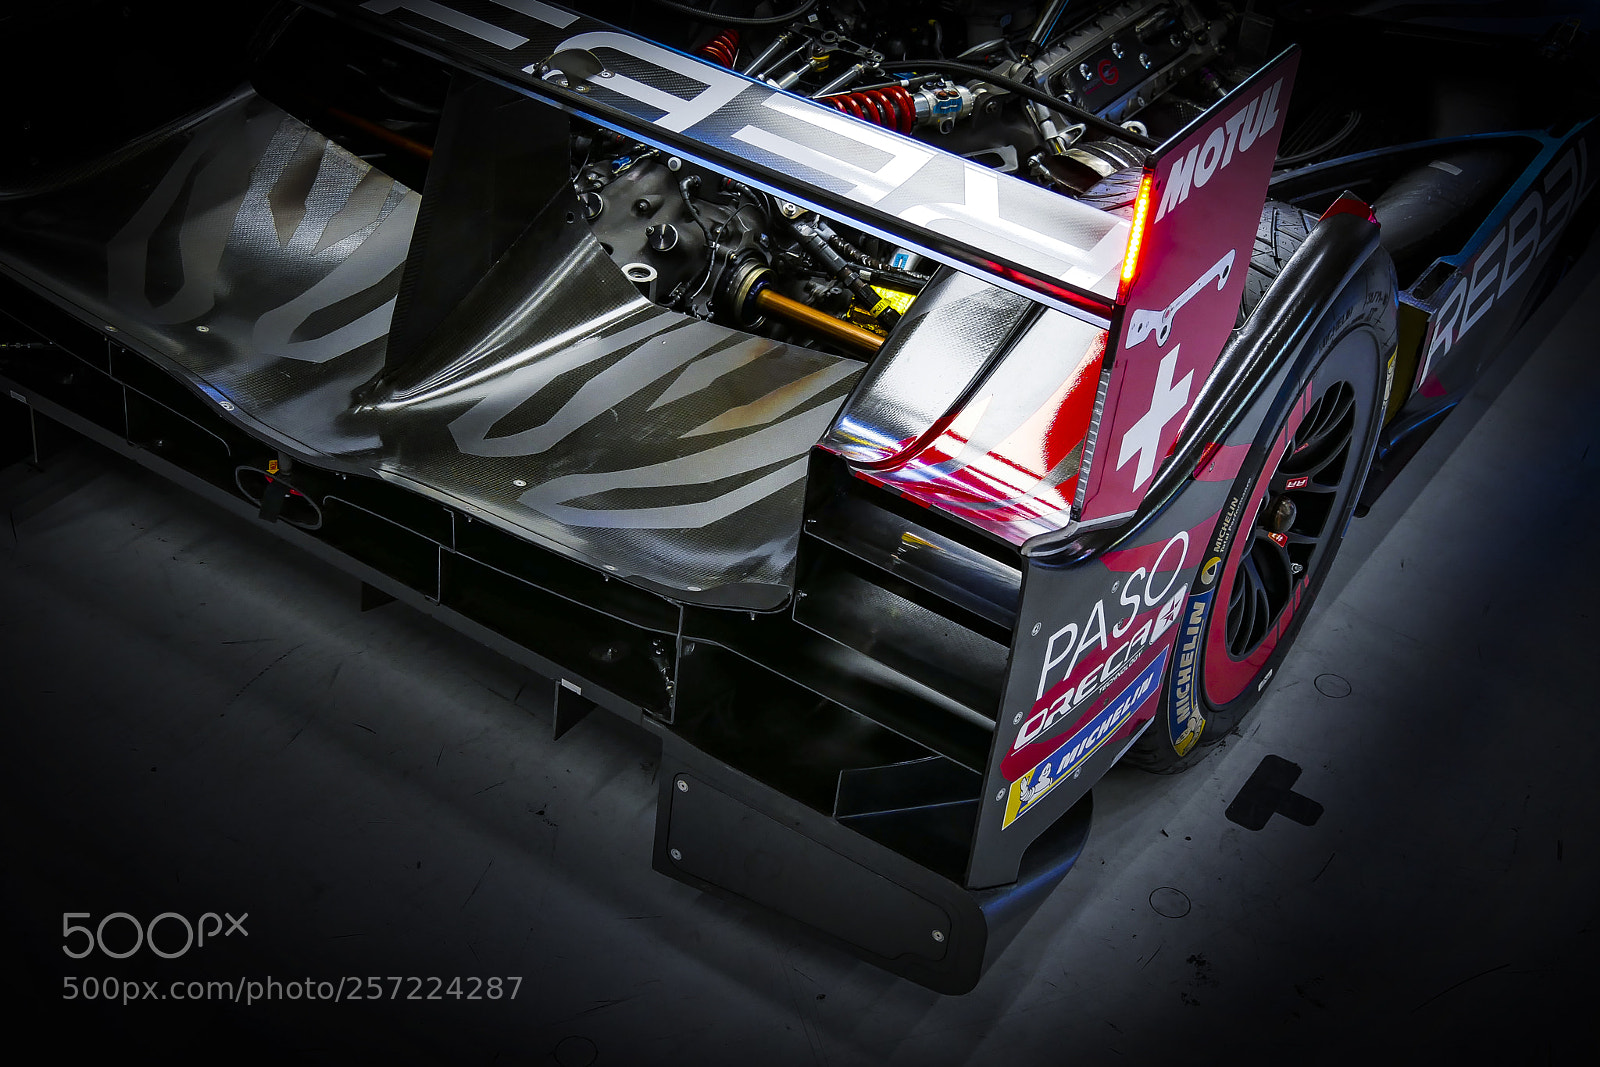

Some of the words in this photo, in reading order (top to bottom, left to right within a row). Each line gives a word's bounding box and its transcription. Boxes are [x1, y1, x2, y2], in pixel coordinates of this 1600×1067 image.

[1154, 77, 1283, 224] MOTUL
[1213, 497, 1239, 553] MICHELIN
[1036, 531, 1189, 701] PASO
[1176, 601, 1206, 724] MICHELIN
[1014, 618, 1154, 750] ORECA
[1056, 672, 1154, 775] MICHELIN
